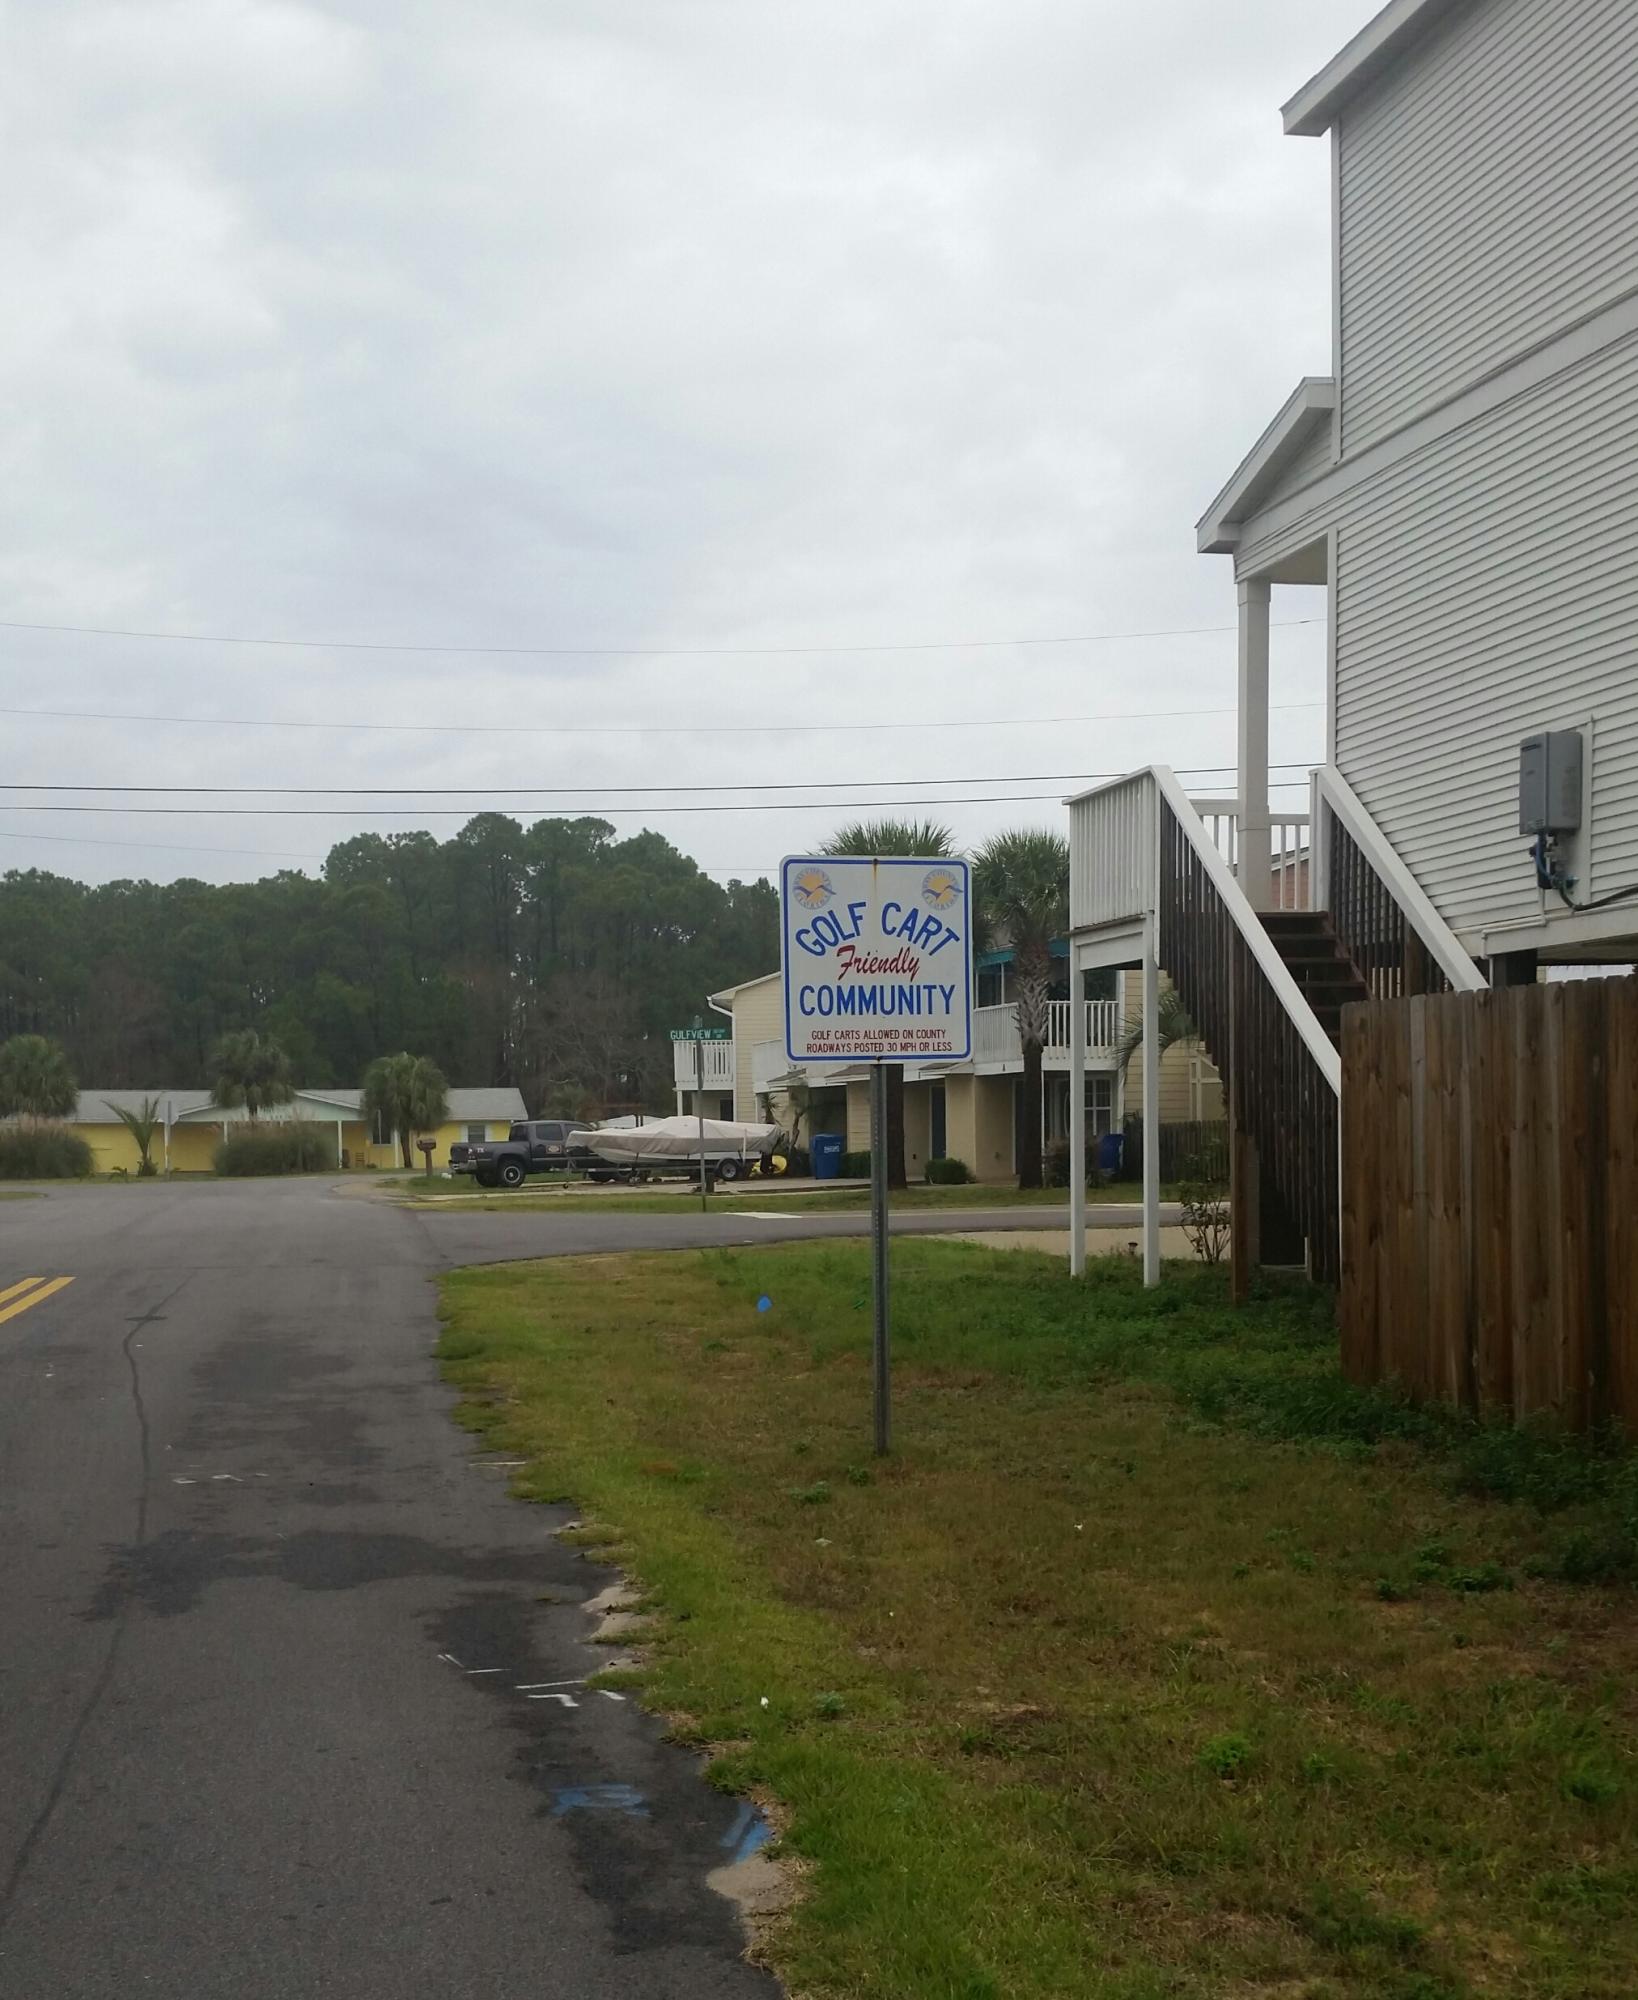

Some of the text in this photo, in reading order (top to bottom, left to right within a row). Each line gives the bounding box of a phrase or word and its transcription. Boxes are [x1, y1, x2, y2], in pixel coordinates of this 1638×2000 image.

[795, 901, 961, 957] GOLF CART
[836, 944, 921, 982] Friendly
[799, 984, 956, 1017] COMMUNITY
[670, 1029, 711, 1040] GULFVIEW
[811, 1029, 946, 1040] GOLF CARTS ALLOWED ON COUNTY
[806, 1041, 952, 1053] ROADWAYS POSTED 30 MPH OR LESS
